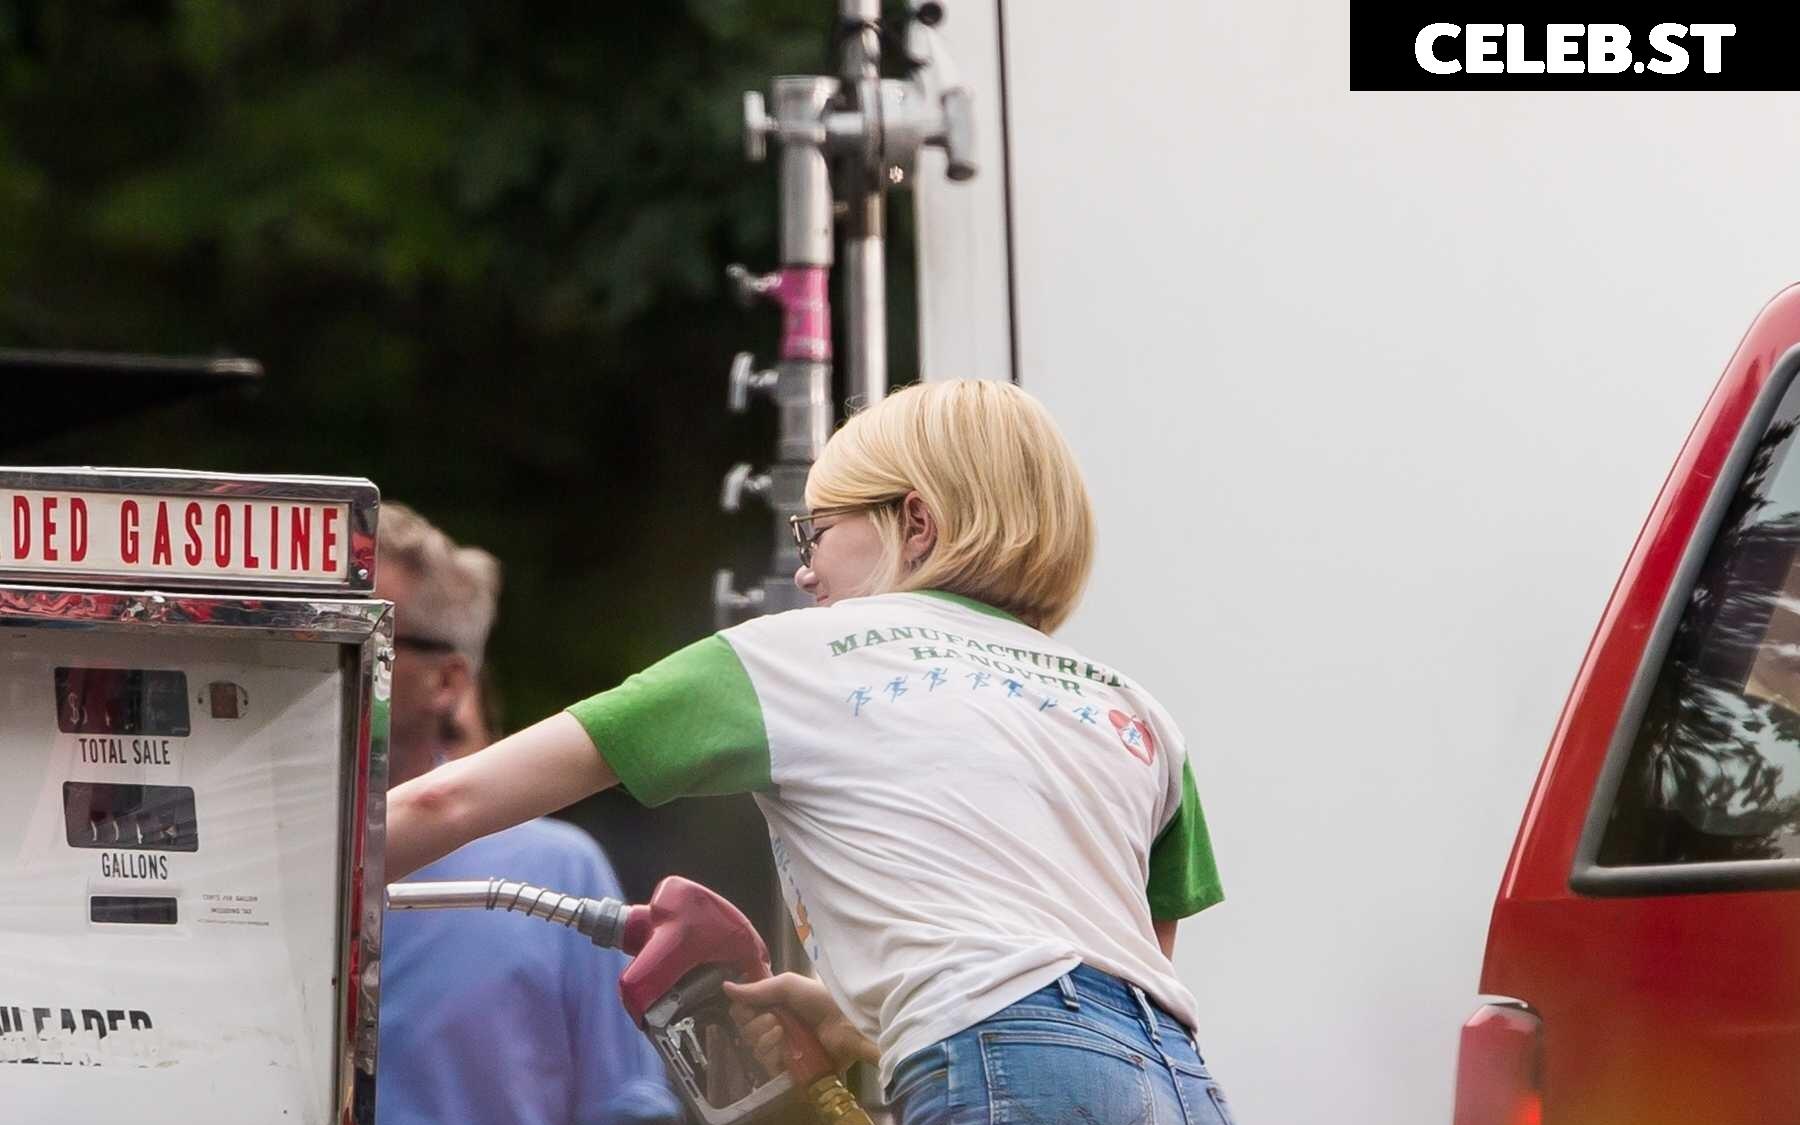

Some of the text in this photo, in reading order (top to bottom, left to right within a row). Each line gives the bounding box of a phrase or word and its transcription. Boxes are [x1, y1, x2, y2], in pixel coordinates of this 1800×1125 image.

[13, 495, 338, 572] DED GASOLINE
[78, 737, 171, 765] TOTAL SALE
[101, 851, 168, 880] GALLONS
